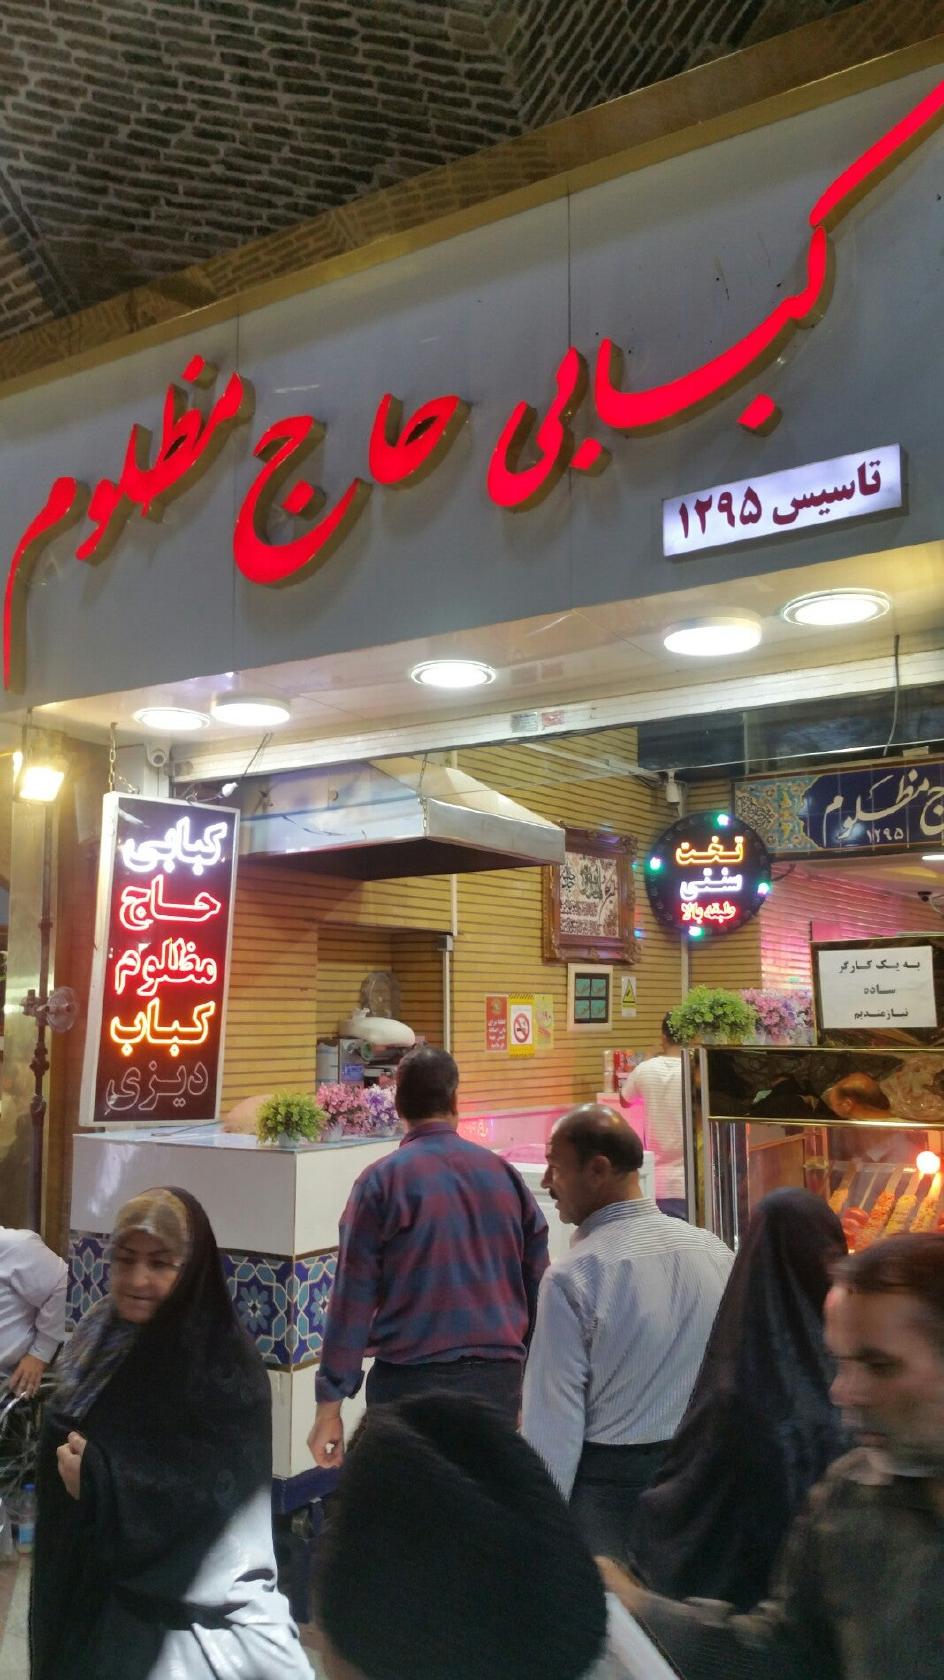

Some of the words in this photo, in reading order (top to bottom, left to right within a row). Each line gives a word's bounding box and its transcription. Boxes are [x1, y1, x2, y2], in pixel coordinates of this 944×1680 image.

[487, 80, 944, 508] کبابی
[233, 393, 462, 584] حاج
[678, 486, 763, 539] ۱۲۹۵
[772, 459, 881, 526] تاسیس
[3, 354, 245, 690] مظلوم
[822, 768, 930, 848] مظلوم
[866, 827, 904, 843] ۱۲۹۵
[119, 815, 228, 876] کبابی
[675, 835, 744, 865] تخت
[119, 874, 222, 931] حاج
[679, 867, 743, 902] سنتی
[680, 901, 704, 924] بالا
[703, 901, 737, 924] طبقه
[863, 983, 897, 995] ساده
[875, 959, 901, 972] یک
[902, 961, 921, 971] به
[109, 996, 216, 1057] کباب
[103, 1058, 209, 1116] دیزی
